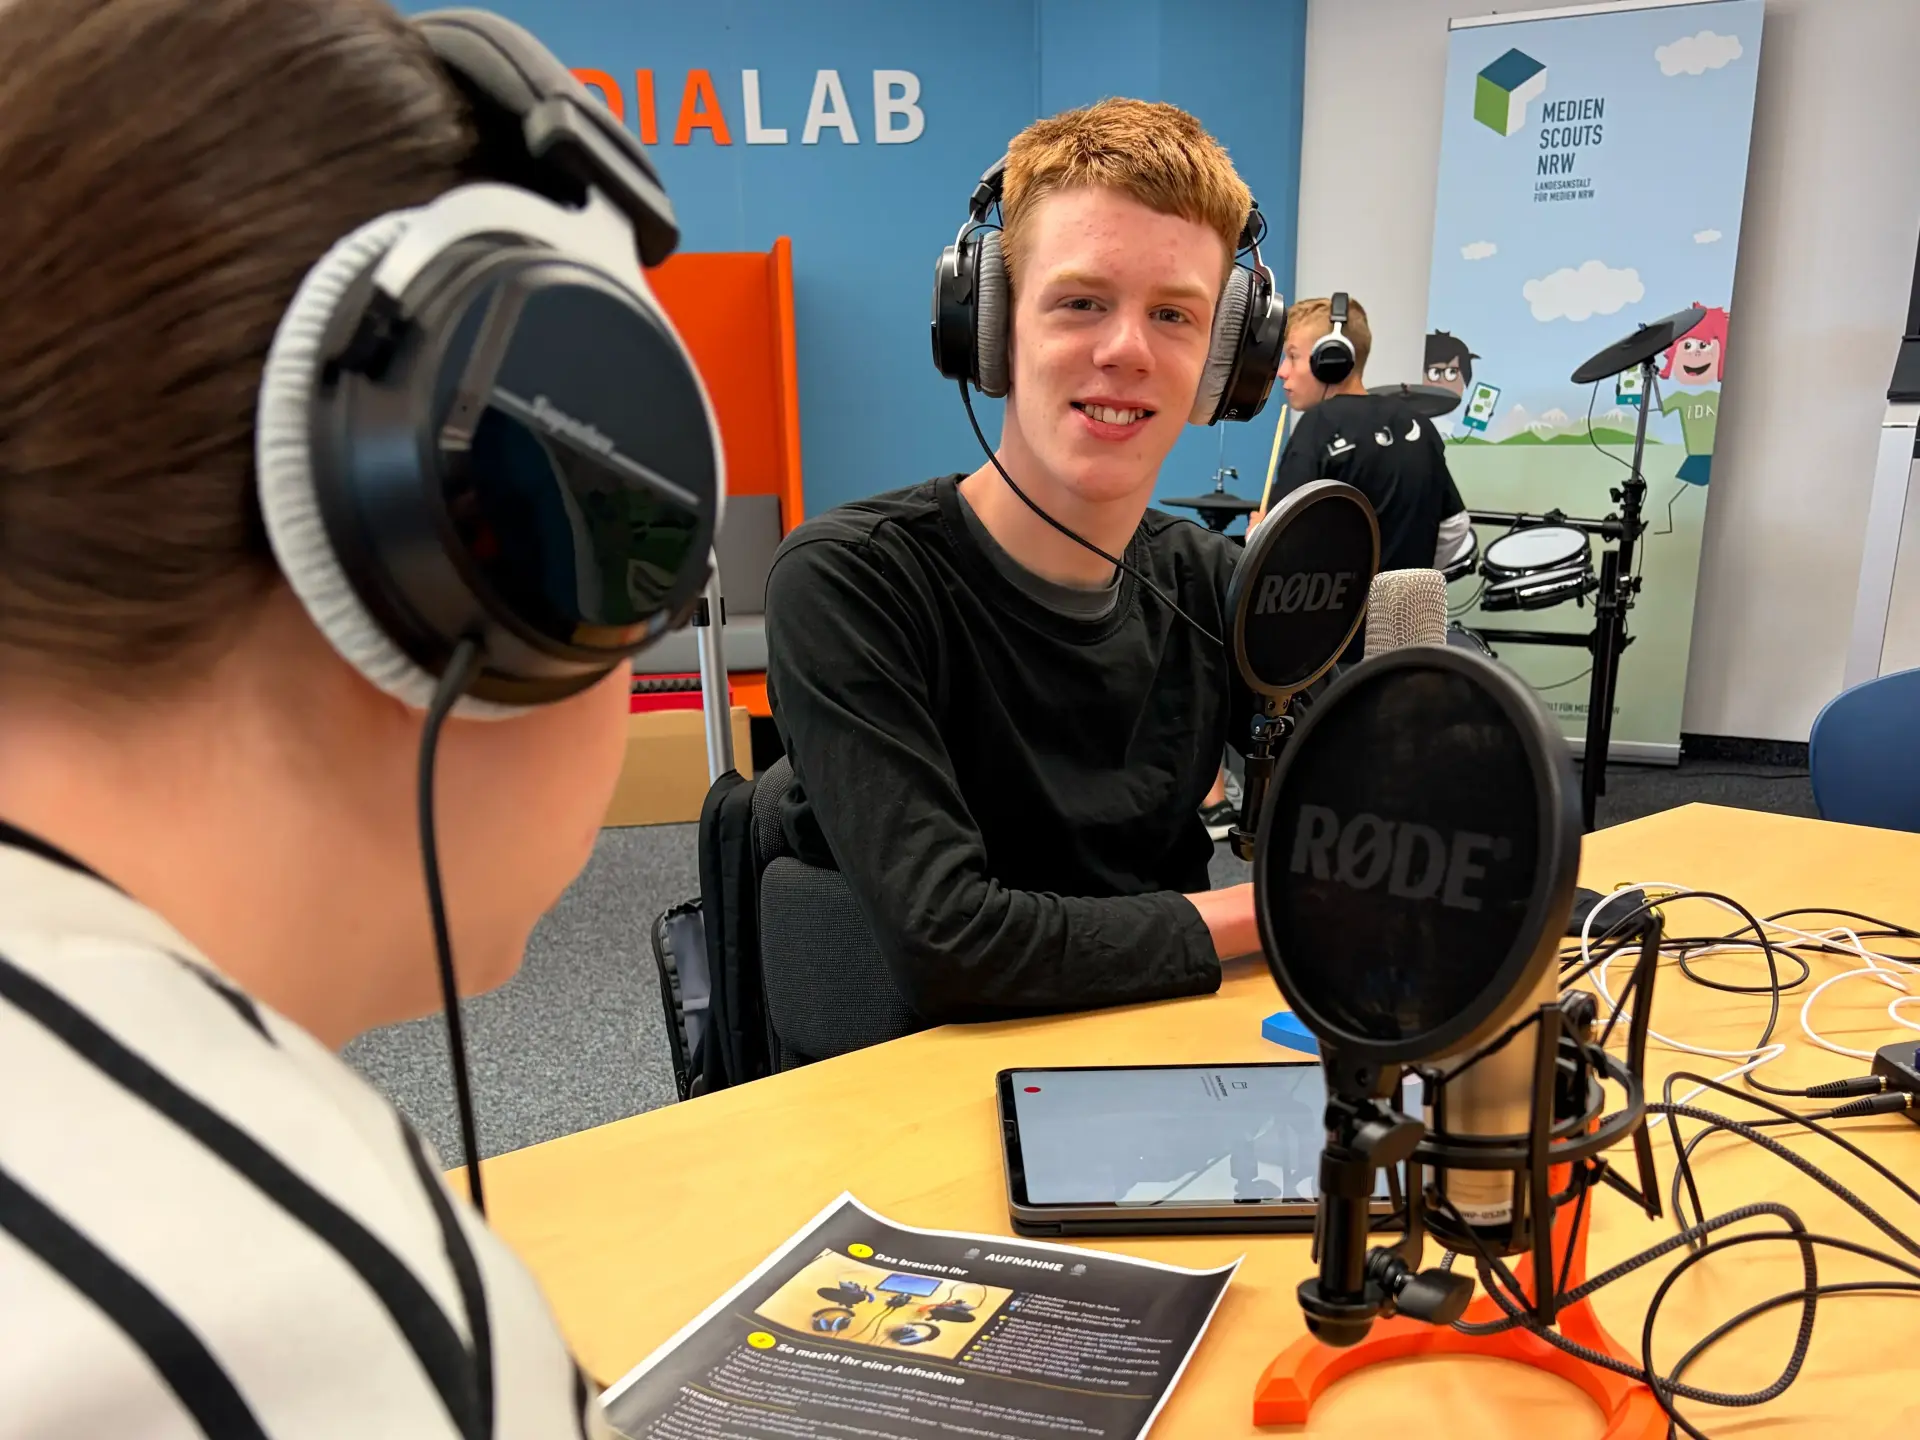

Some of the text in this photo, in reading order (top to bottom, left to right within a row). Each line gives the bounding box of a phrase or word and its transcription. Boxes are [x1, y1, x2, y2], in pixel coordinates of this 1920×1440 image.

[1541, 98, 1605, 123] MEDIEN
[1539, 125, 1603, 149] SCOUTS
[1537, 153, 1576, 175] NRW
[1533, 189, 1595, 202] FÜR MEDIEN NRW
[1534, 178, 1592, 191] LANDESANSTALT
[874, 1252, 899, 1266] Das
[898, 1257, 948, 1274] braucht
[948, 1265, 969, 1277] ihr
[984, 1253, 1064, 1272] AUFNAHME
[776, 1342, 796, 1355] So
[796, 1347, 840, 1364] macht
[839, 1354, 862, 1368] ihr
[861, 1359, 893, 1373] eine
[892, 1363, 966, 1386] Aufnahme
